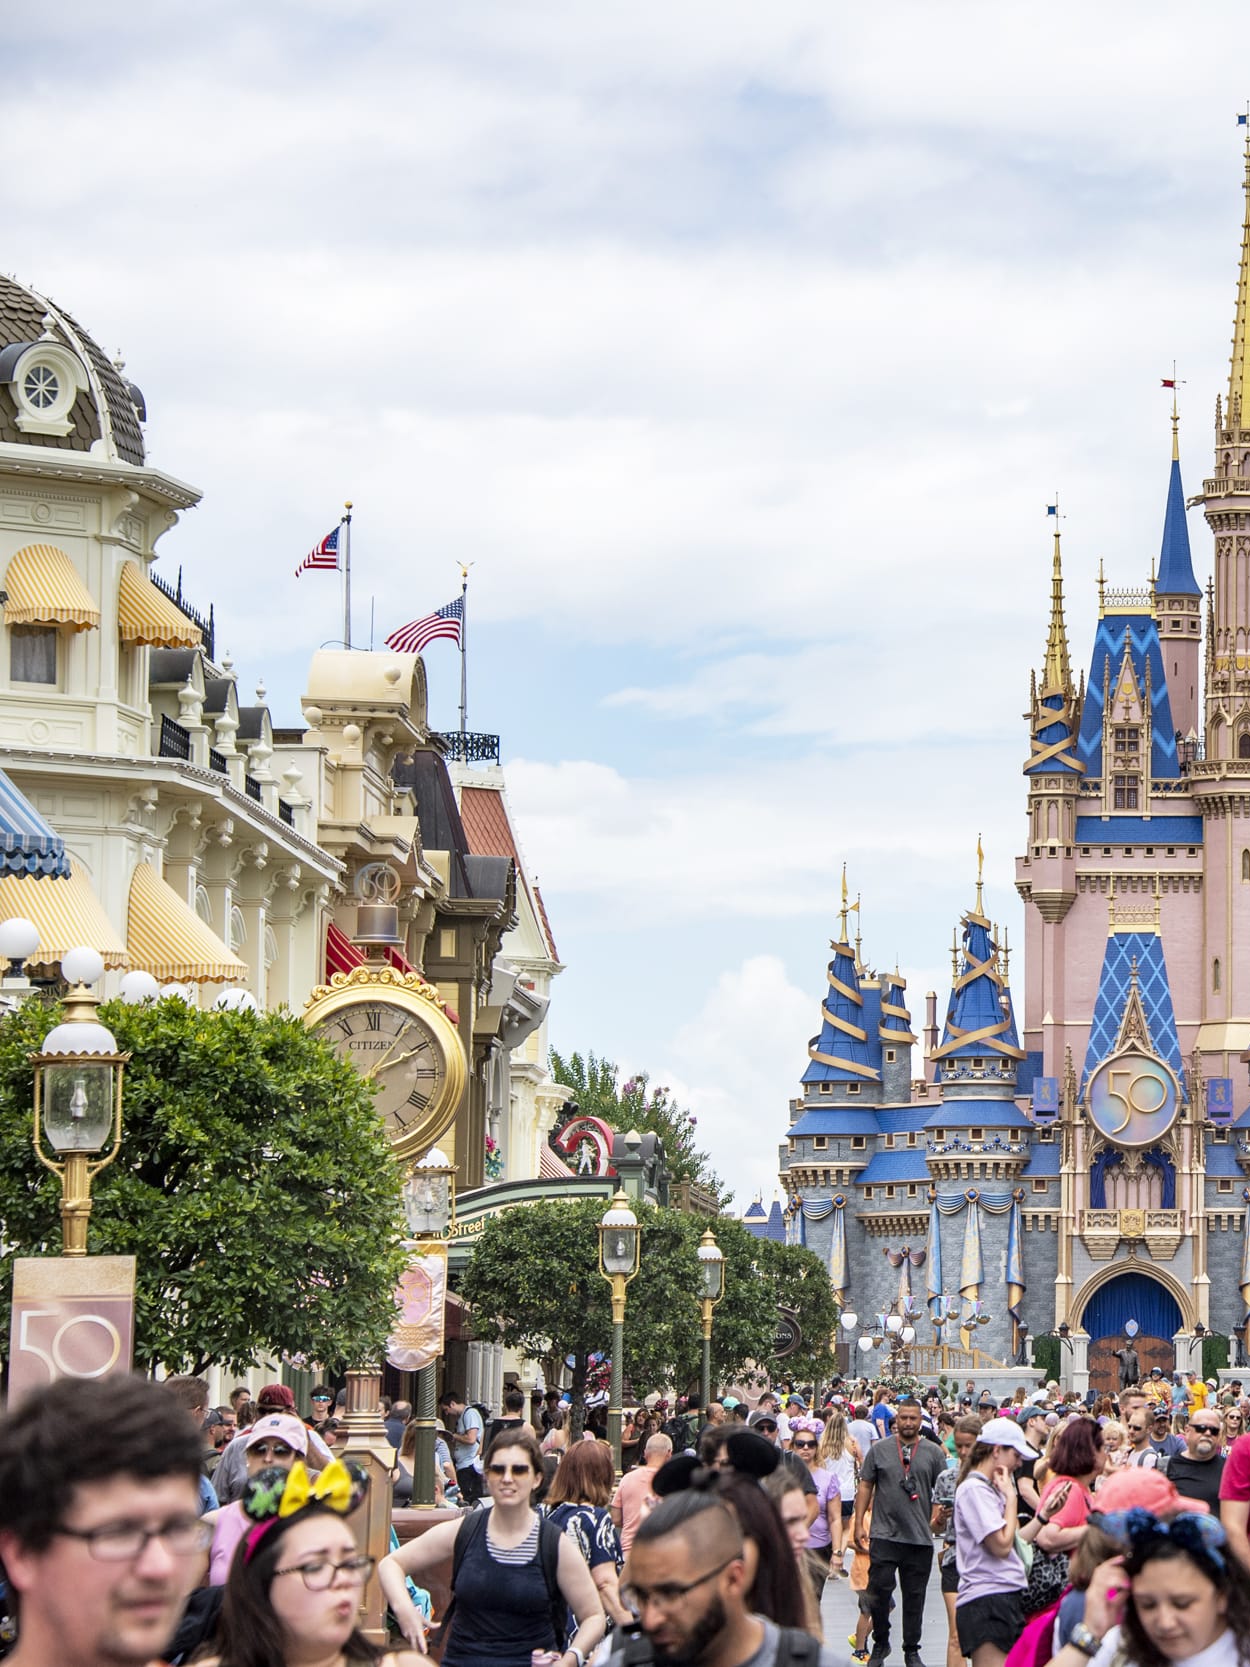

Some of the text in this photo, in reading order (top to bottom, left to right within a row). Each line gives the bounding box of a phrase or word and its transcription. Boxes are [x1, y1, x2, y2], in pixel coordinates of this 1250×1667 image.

[348, 1040, 395, 1050] CITIZEN
[1108, 1069, 1168, 1135] 50
[450, 1216, 487, 1238] Street
[20, 1310, 121, 1385] 50
